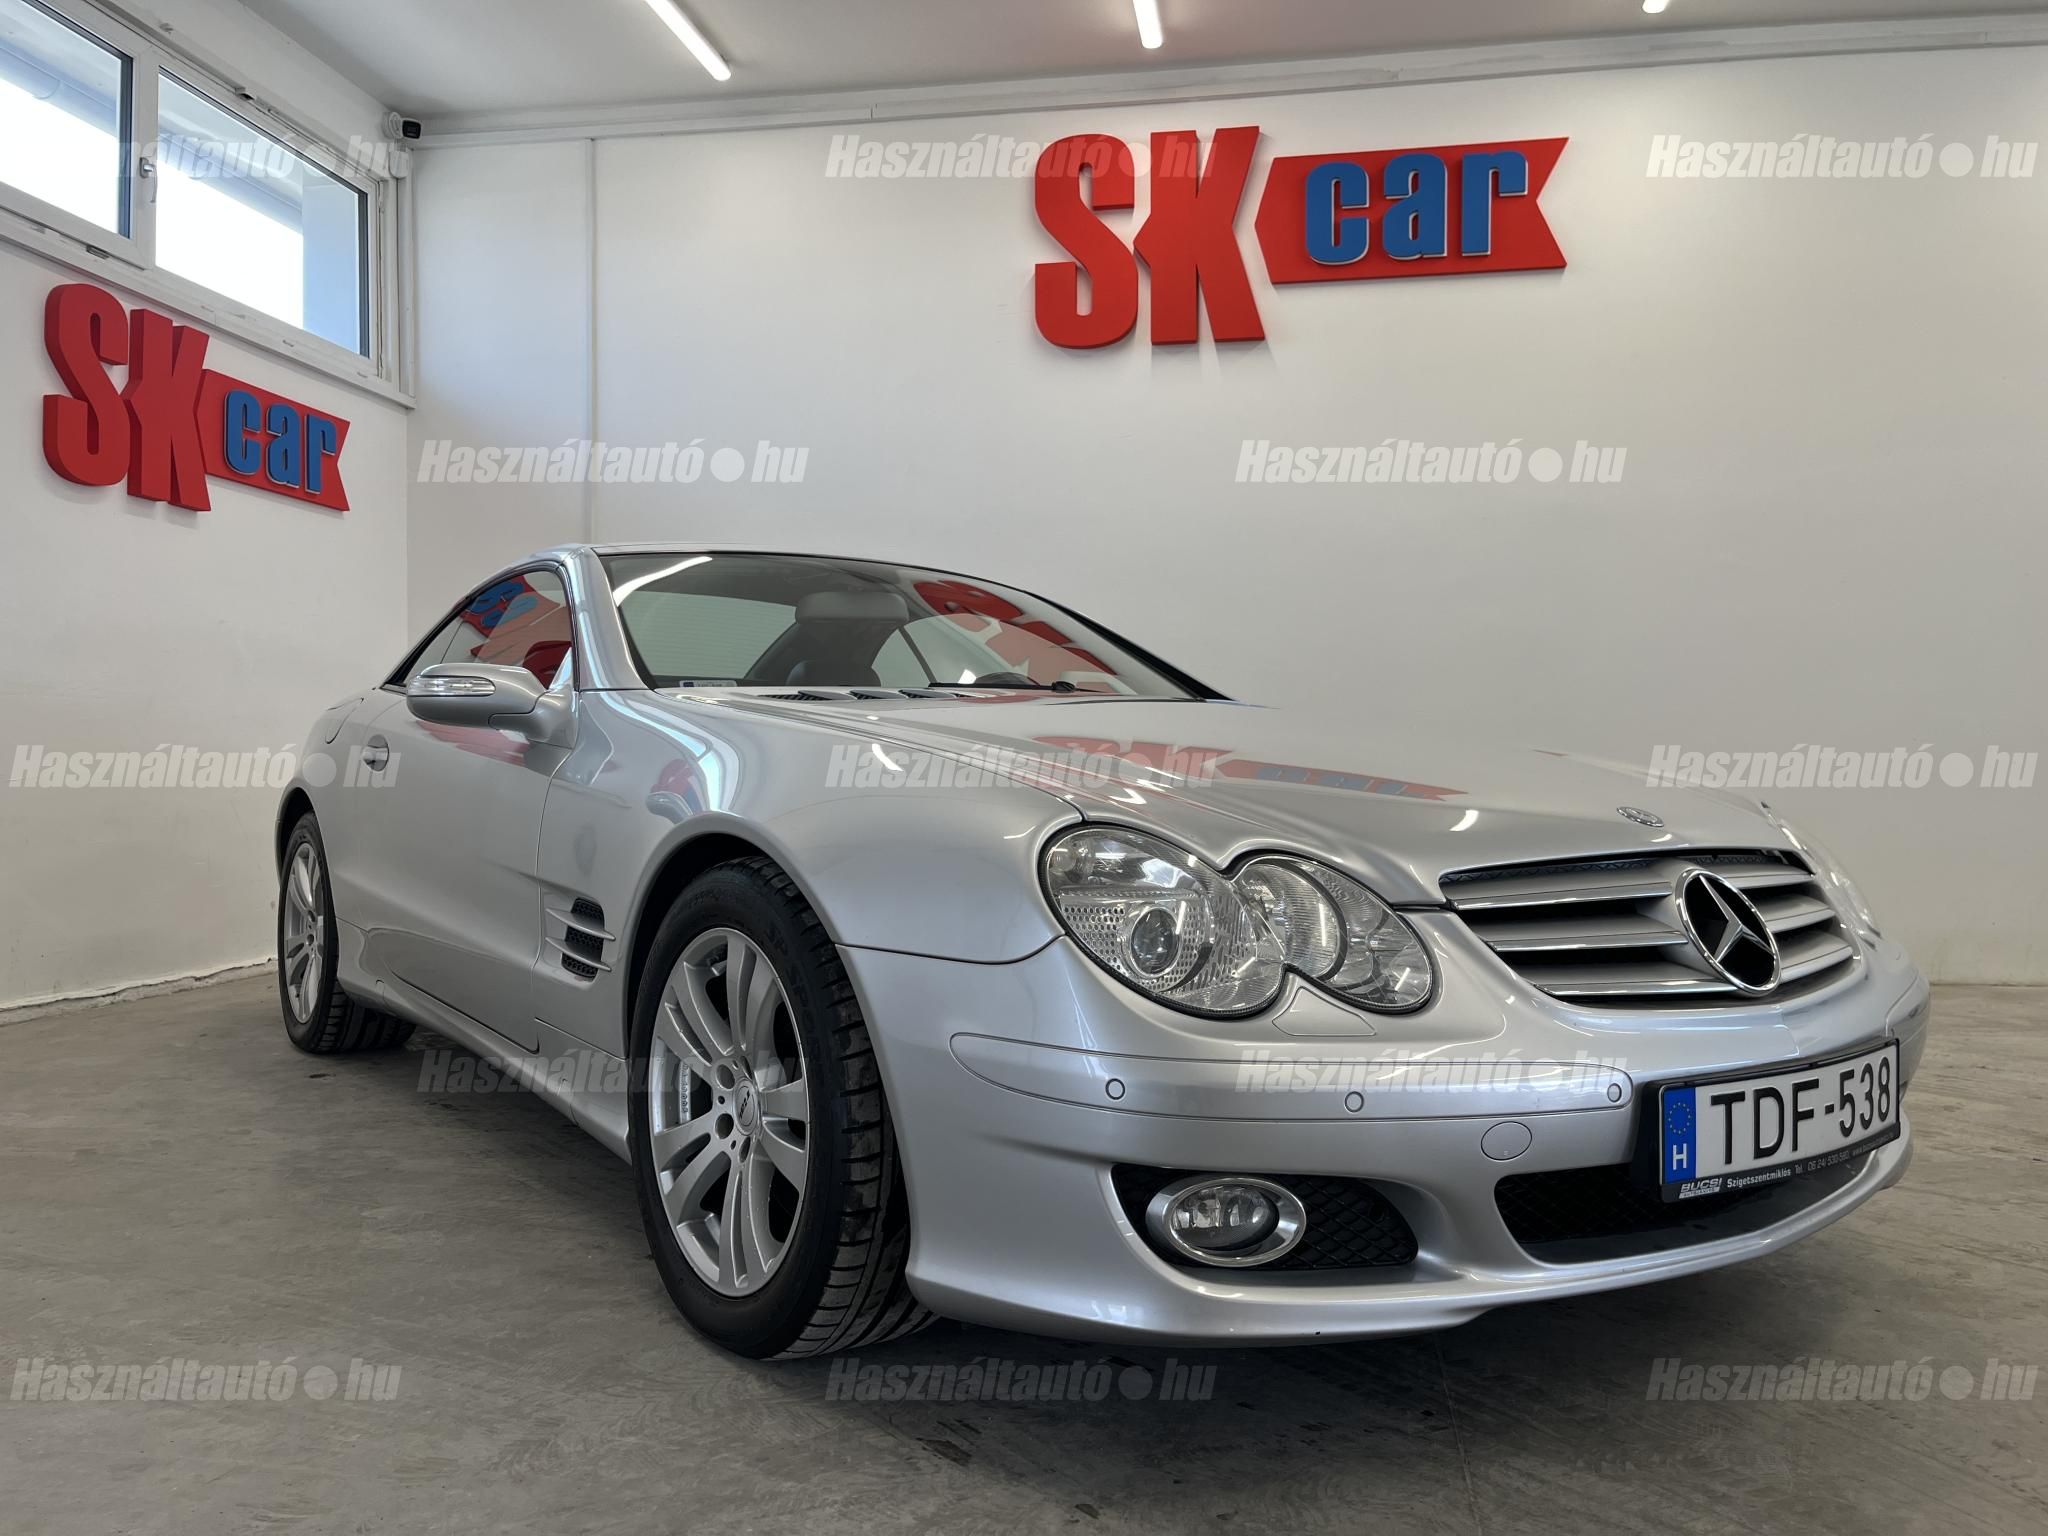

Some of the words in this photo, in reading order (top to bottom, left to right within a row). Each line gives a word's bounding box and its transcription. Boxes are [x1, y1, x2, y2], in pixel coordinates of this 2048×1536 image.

[1035, 126, 1265, 348] SK
[1305, 150, 1528, 265] car
[43, 283, 211, 511] SK
[224, 389, 337, 495] car
[1672, 1143, 1688, 1170] H
[1709, 1056, 1891, 1165] TDF-538
